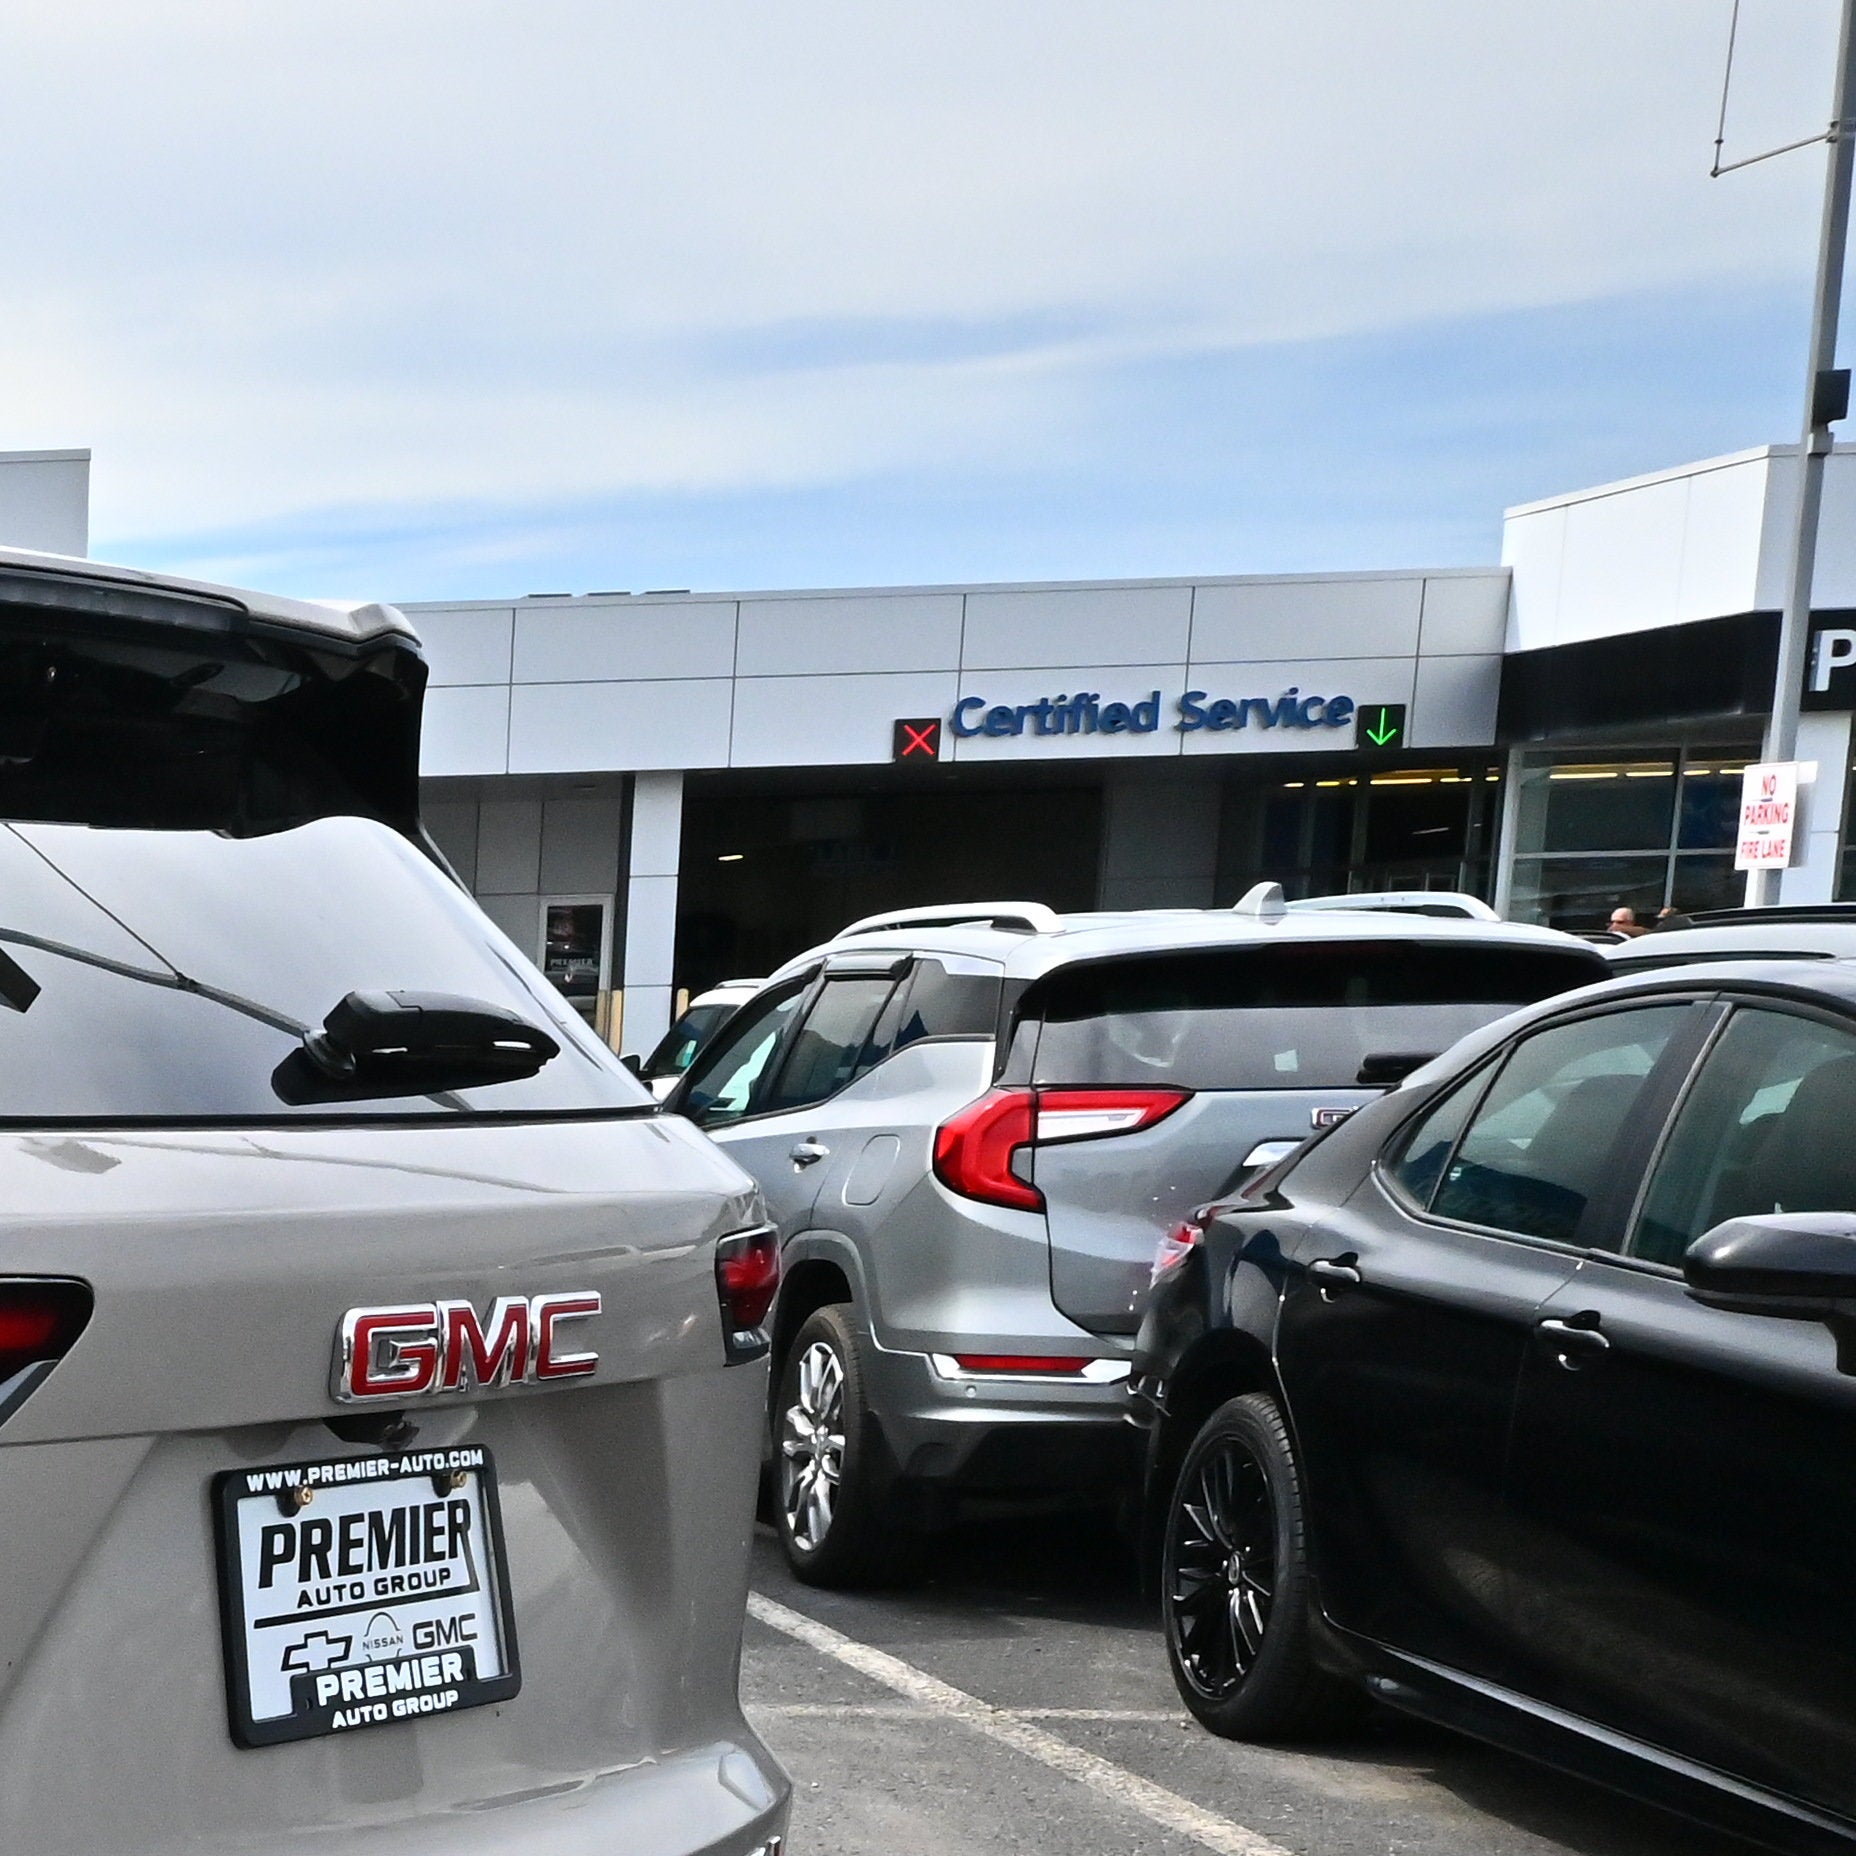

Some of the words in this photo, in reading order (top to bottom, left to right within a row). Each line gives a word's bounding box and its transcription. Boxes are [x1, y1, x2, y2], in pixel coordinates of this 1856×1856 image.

[952, 690, 1161, 737] Certified
[1178, 687, 1354, 732] Service
[1761, 775, 1776, 796] NO
[1745, 802, 1789, 825] PARKING
[1741, 840, 1759, 859] FIRE
[1761, 839, 1786, 858] LANE
[330, 1290, 602, 1404] GMC
[246, 1449, 484, 1493] WWW.PREMIER-AUTO.COM
[258, 1499, 472, 1589] PREMIER
[297, 1581, 365, 1608] AUTO
[374, 1567, 451, 1595] GROUP
[362, 1635, 404, 1650] NISSAN
[412, 1613, 478, 1650] GMC
[316, 1652, 464, 1706] PREMIER
[332, 1702, 388, 1728] AUTO
[392, 1690, 459, 1717] GROUP
